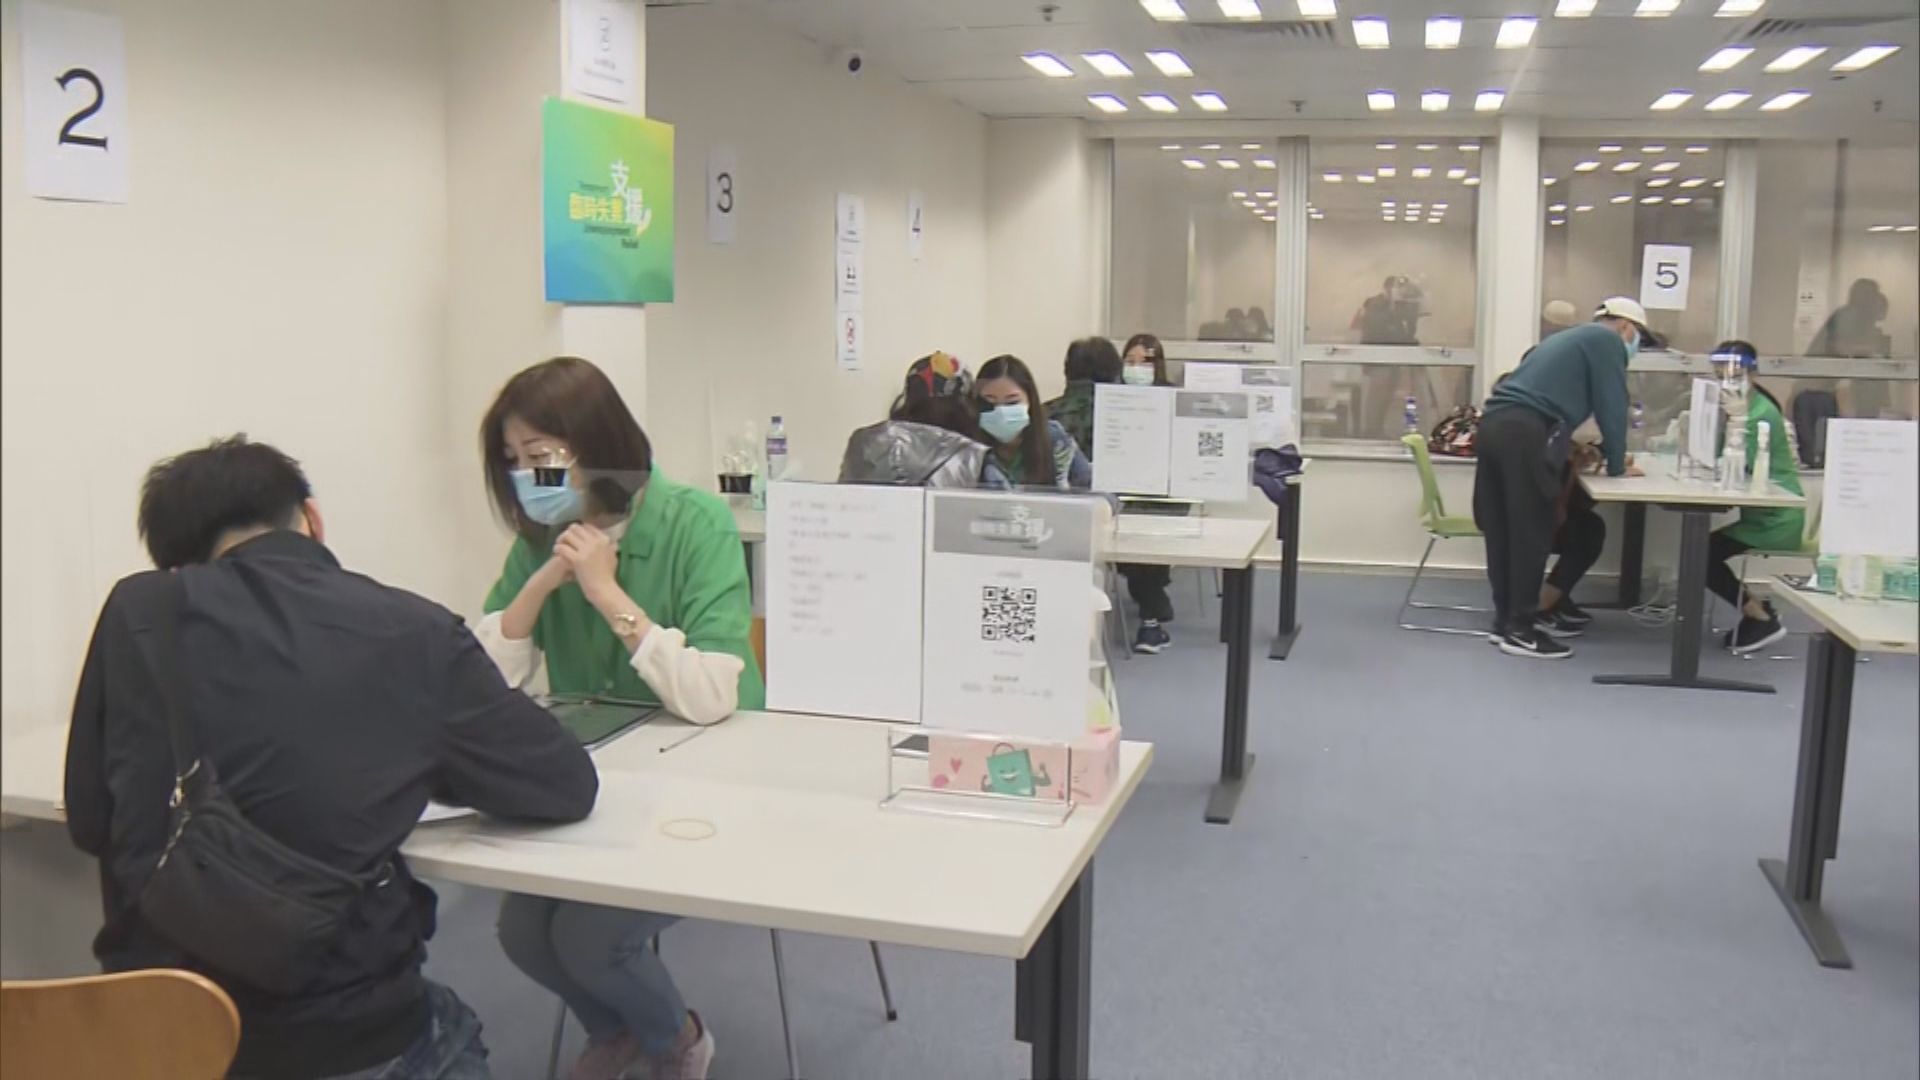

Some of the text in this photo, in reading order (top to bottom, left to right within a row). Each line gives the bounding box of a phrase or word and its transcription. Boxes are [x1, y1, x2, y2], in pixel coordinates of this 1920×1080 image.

[54, 67, 108, 151] 2
[717, 171, 733, 213] 3
[1655, 261, 1679, 289] 5
